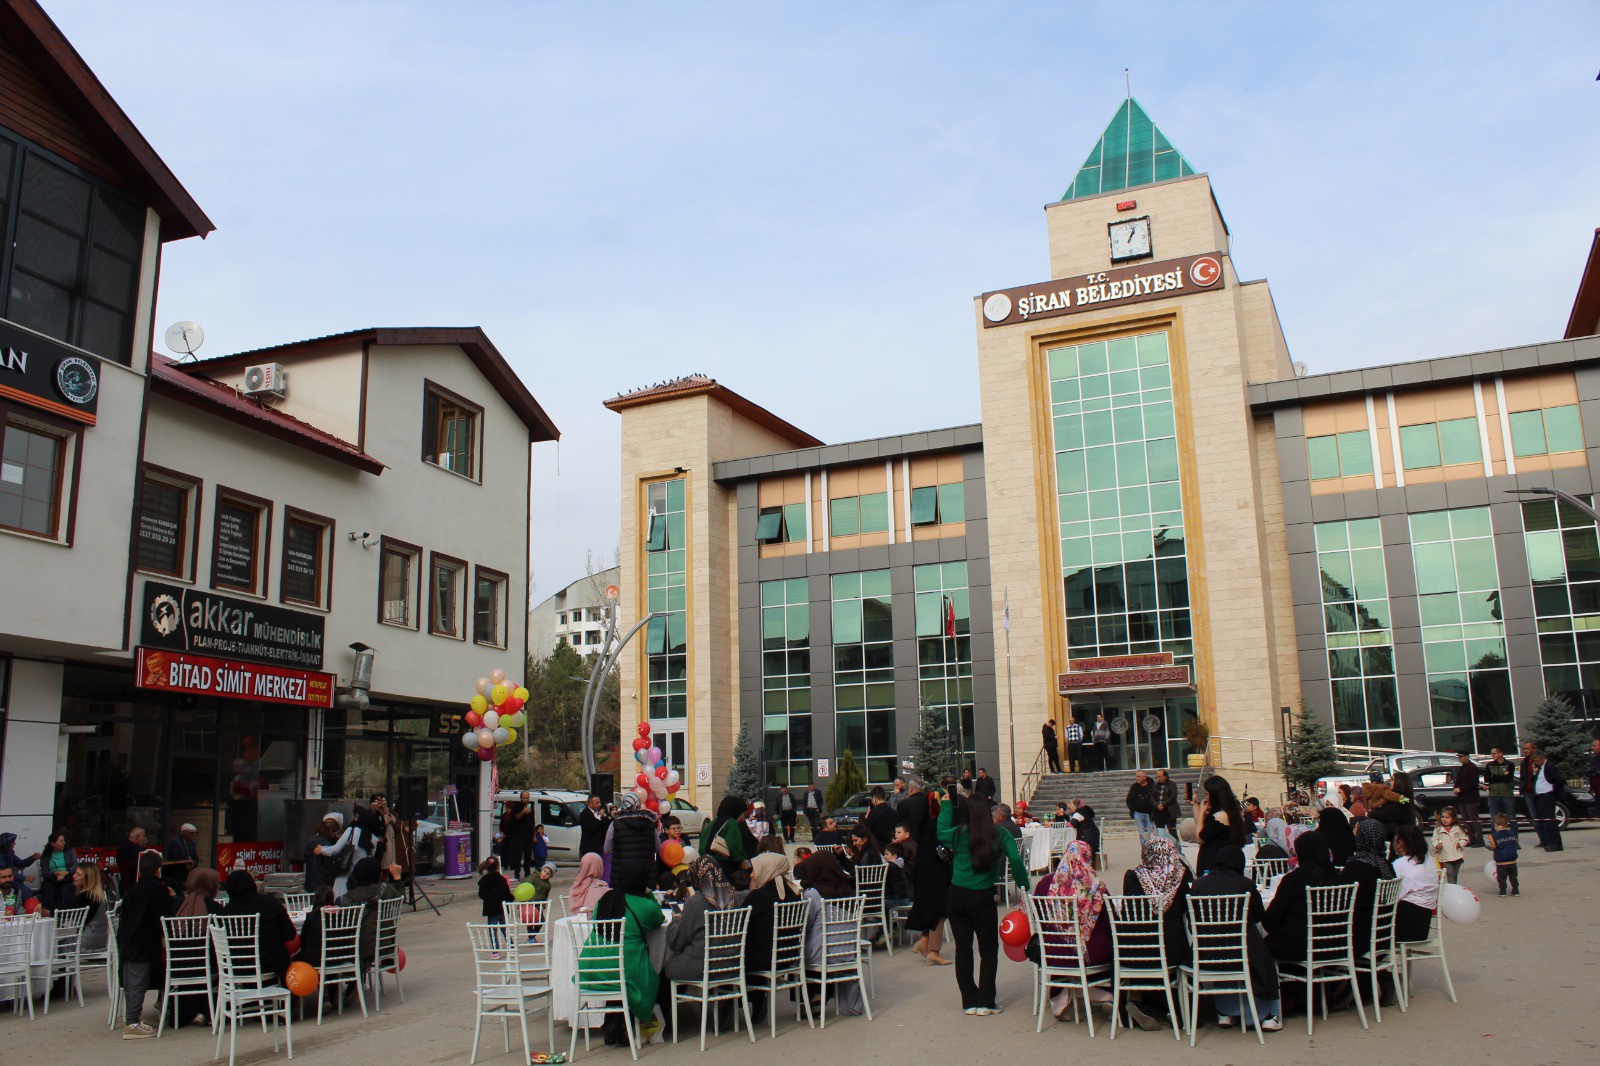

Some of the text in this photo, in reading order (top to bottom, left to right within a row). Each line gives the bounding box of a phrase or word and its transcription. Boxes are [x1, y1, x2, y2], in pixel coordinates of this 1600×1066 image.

[1018, 266, 1184, 320] ŞİRAN BELEDİYESİ
[1087, 272, 1110, 285] T.C.
[190, 598, 321, 650] akkar MÜHENDİSLİK
[169, 656, 307, 701] BİTAD SİMİT MERKEZİ
[1060, 669, 1184, 689] ŞİRAN BELEDİYESİ
